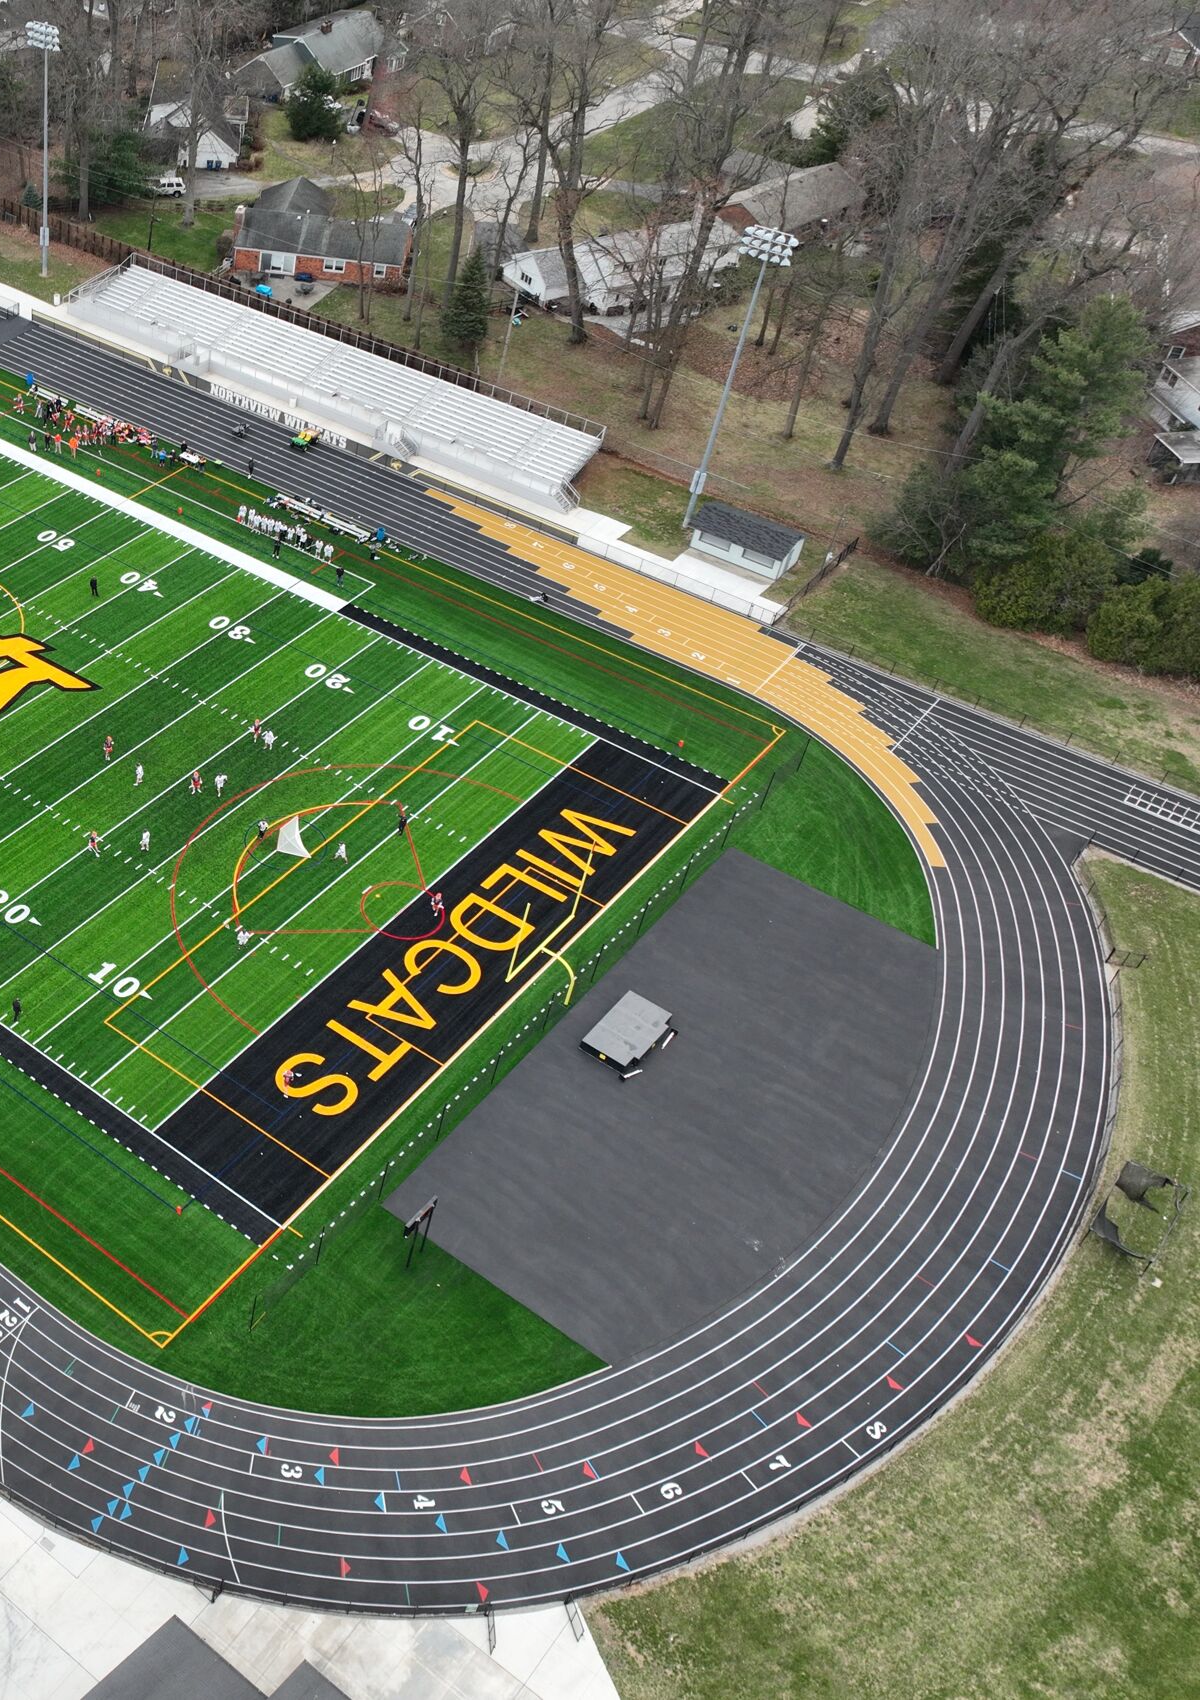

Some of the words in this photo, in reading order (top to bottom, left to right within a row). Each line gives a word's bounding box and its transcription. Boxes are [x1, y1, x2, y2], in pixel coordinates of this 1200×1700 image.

[210, 383, 281, 422] NORTHVIEW
[36, 530, 76, 552] 50
[119, 571, 158, 593] 40
[503, 521, 518, 530] 8
[531, 540, 545, 549] 7
[562, 562, 576, 570] 6
[592, 582, 607, 592] 5
[624, 604, 639, 614] 4
[656, 628, 672, 637] 3
[690, 651, 706, 661] 2
[726, 676, 741, 685] 1
[208, 615, 251, 641] 30
[304, 663, 351, 690] 20
[407, 714, 455, 743] 10
[274, 808, 637, 1116] WILDCATS
[87, 961, 140, 998] 10
[13, 1297, 31, 1313] 1
[154, 1406, 176, 1424] 2
[280, 1463, 302, 1478] 3
[412, 1494, 436, 1510] 4
[540, 1499, 566, 1514] 5
[660, 1482, 682, 1500] 6
[768, 1454, 792, 1470] 7
[866, 1421, 887, 1440] 8
